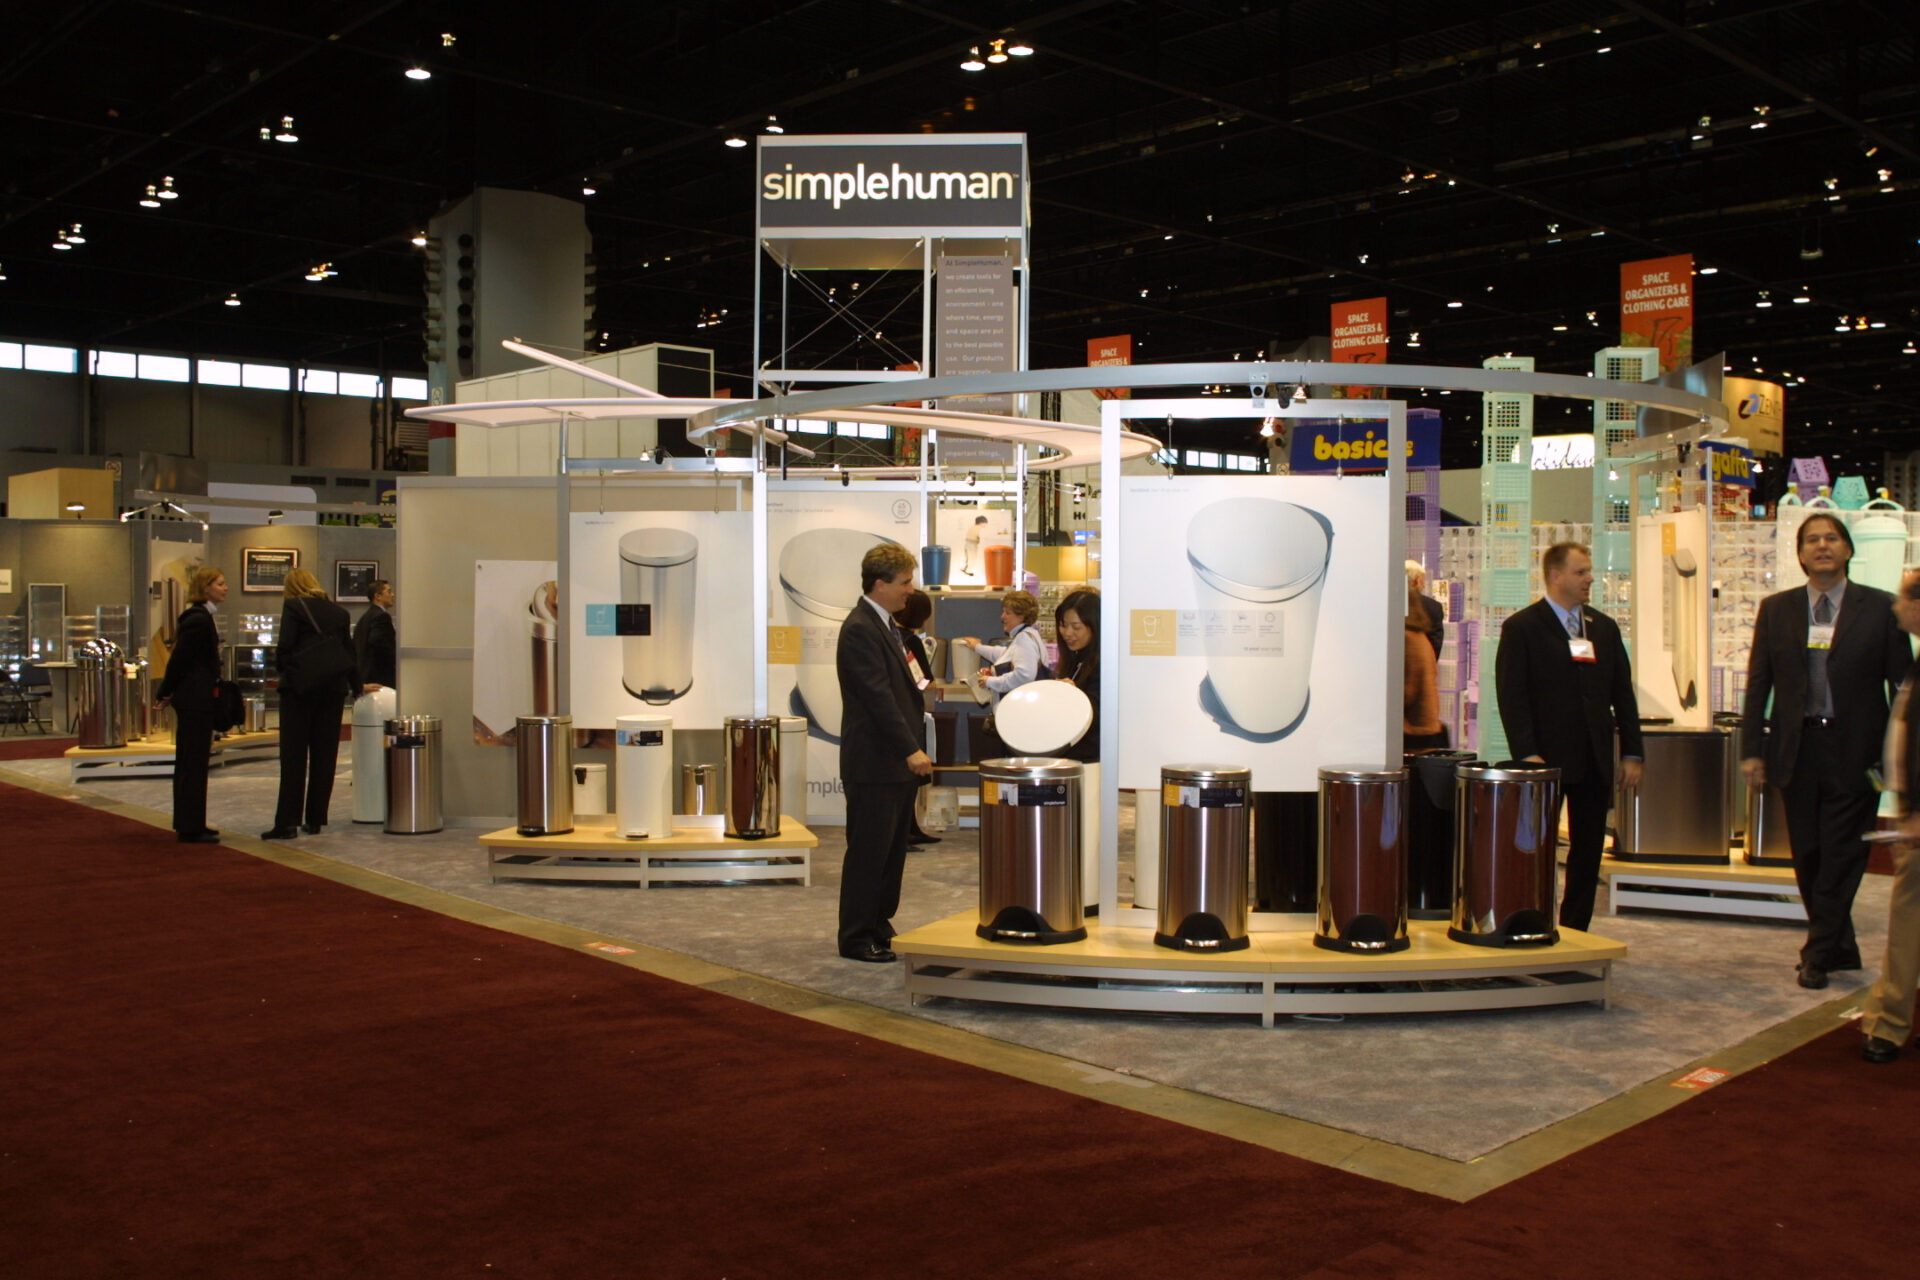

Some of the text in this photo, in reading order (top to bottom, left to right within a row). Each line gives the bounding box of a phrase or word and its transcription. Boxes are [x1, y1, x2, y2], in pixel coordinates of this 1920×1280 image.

[1642, 272, 1670, 286] SPACE
[1625, 282, 1686, 301] ORGANIZERS &
[1622, 296, 1690, 314] CLOTHING CARE
[1348, 312, 1369, 324] SPACE
[1334, 322, 1382, 338] ORGANIZERS &
[1332, 334, 1385, 349] CLOTHING CARE
